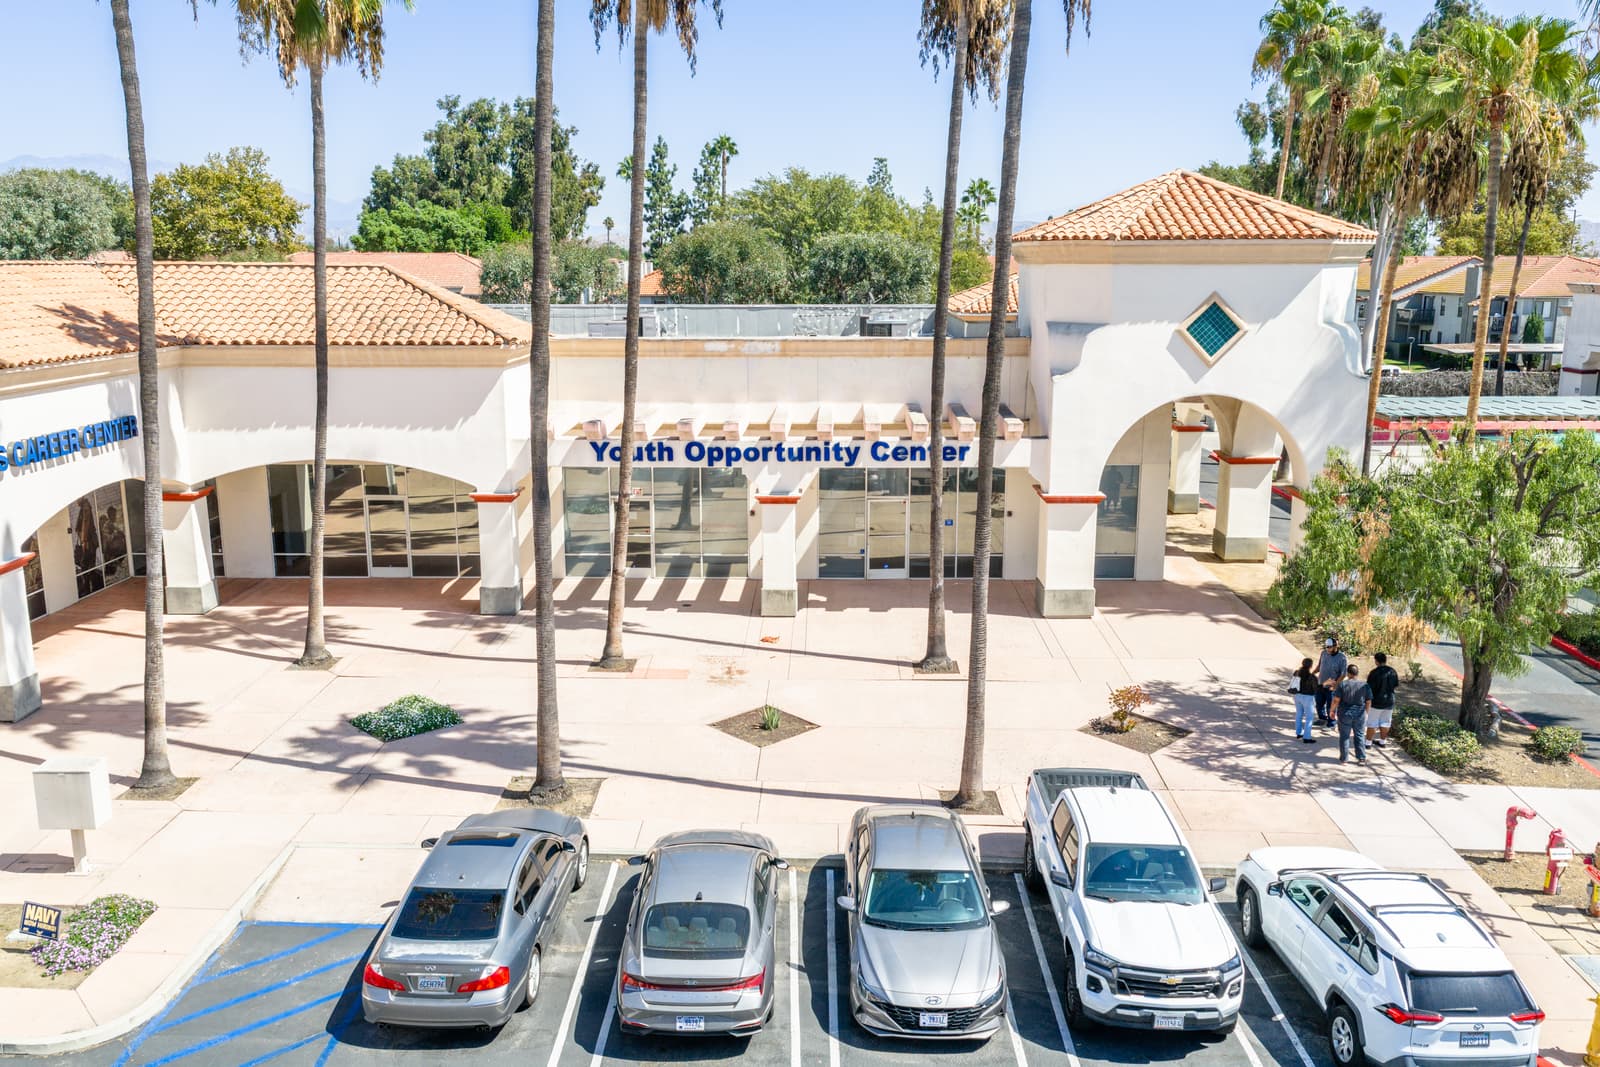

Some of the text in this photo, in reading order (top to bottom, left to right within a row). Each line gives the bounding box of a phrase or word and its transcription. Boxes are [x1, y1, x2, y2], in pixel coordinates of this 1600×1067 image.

[12, 428, 80, 467] CAREER
[82, 415, 139, 449] CENTER
[589, 440, 971, 466] Youth Opportunity Cener
[25, 904, 59, 925] NAVY
